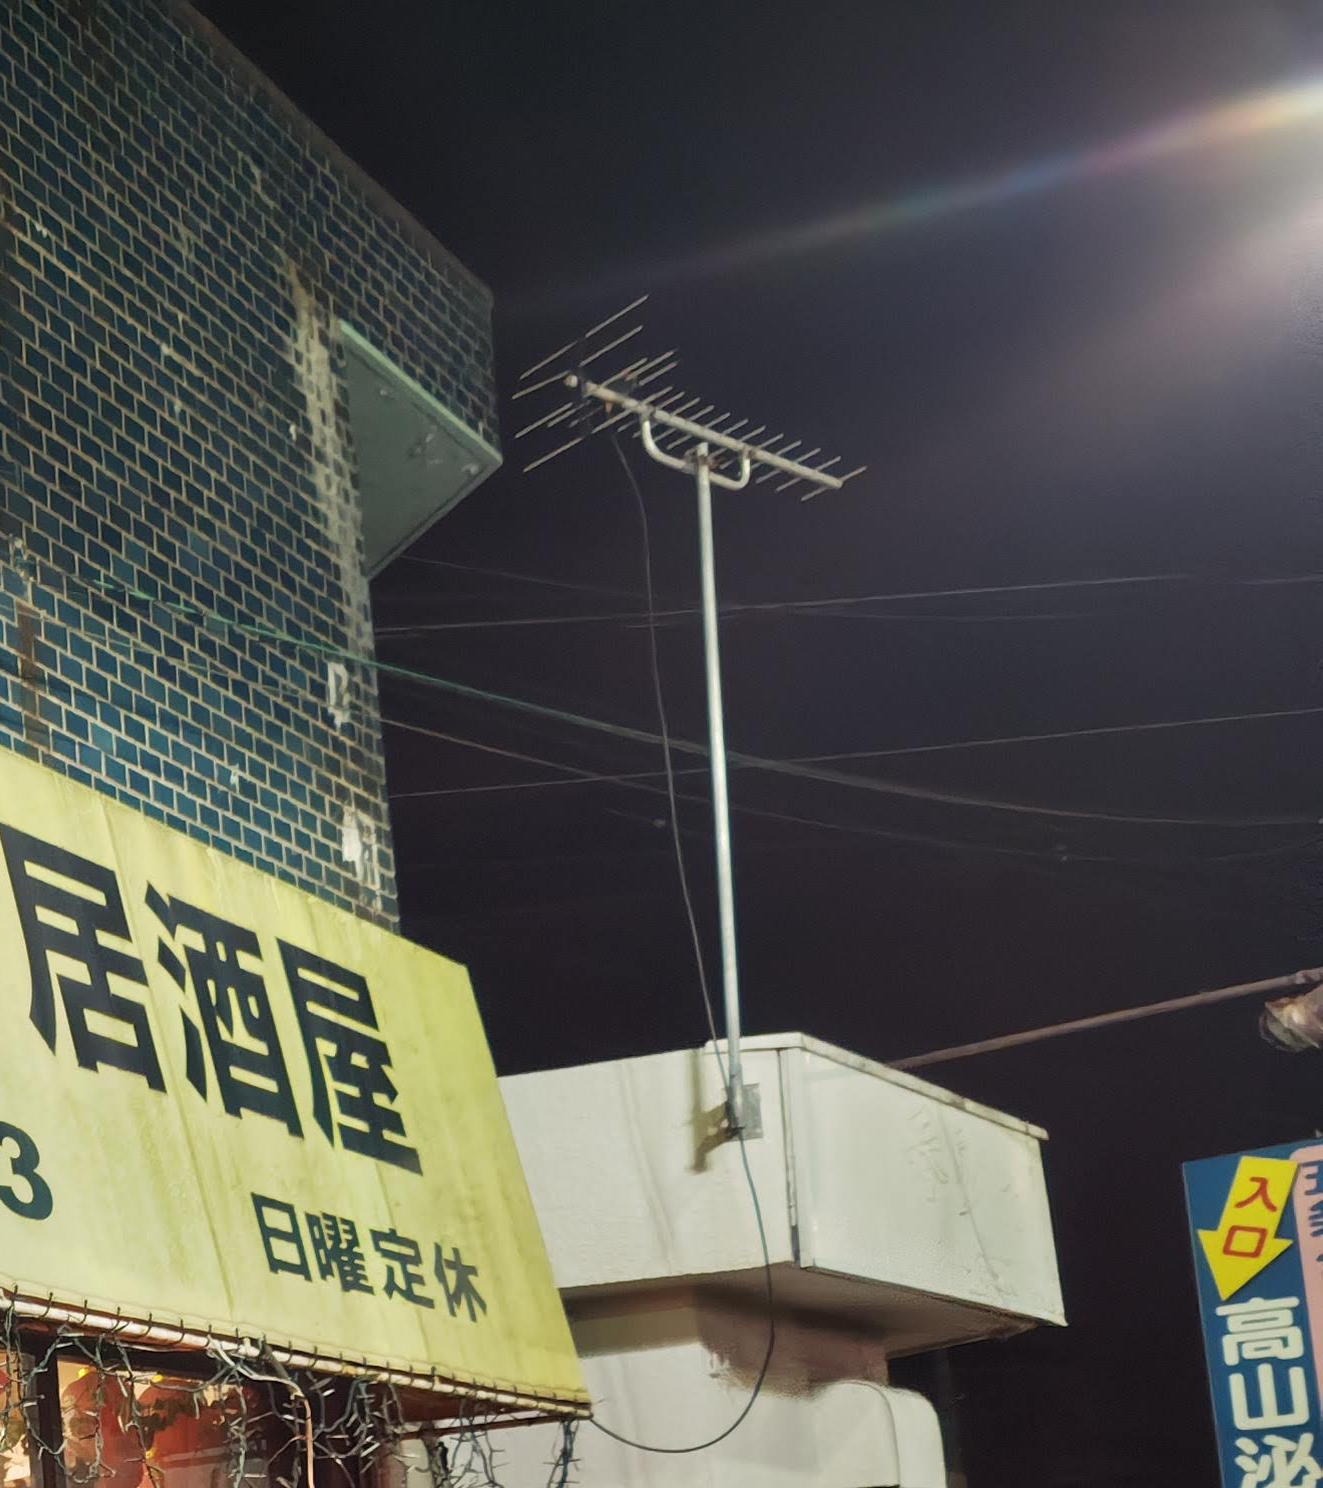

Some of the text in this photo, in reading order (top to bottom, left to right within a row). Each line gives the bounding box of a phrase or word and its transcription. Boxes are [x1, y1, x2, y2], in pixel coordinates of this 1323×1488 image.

[251, 1192, 487, 1322] 日曜定休
[1222, 1176, 1278, 1259] 入口
